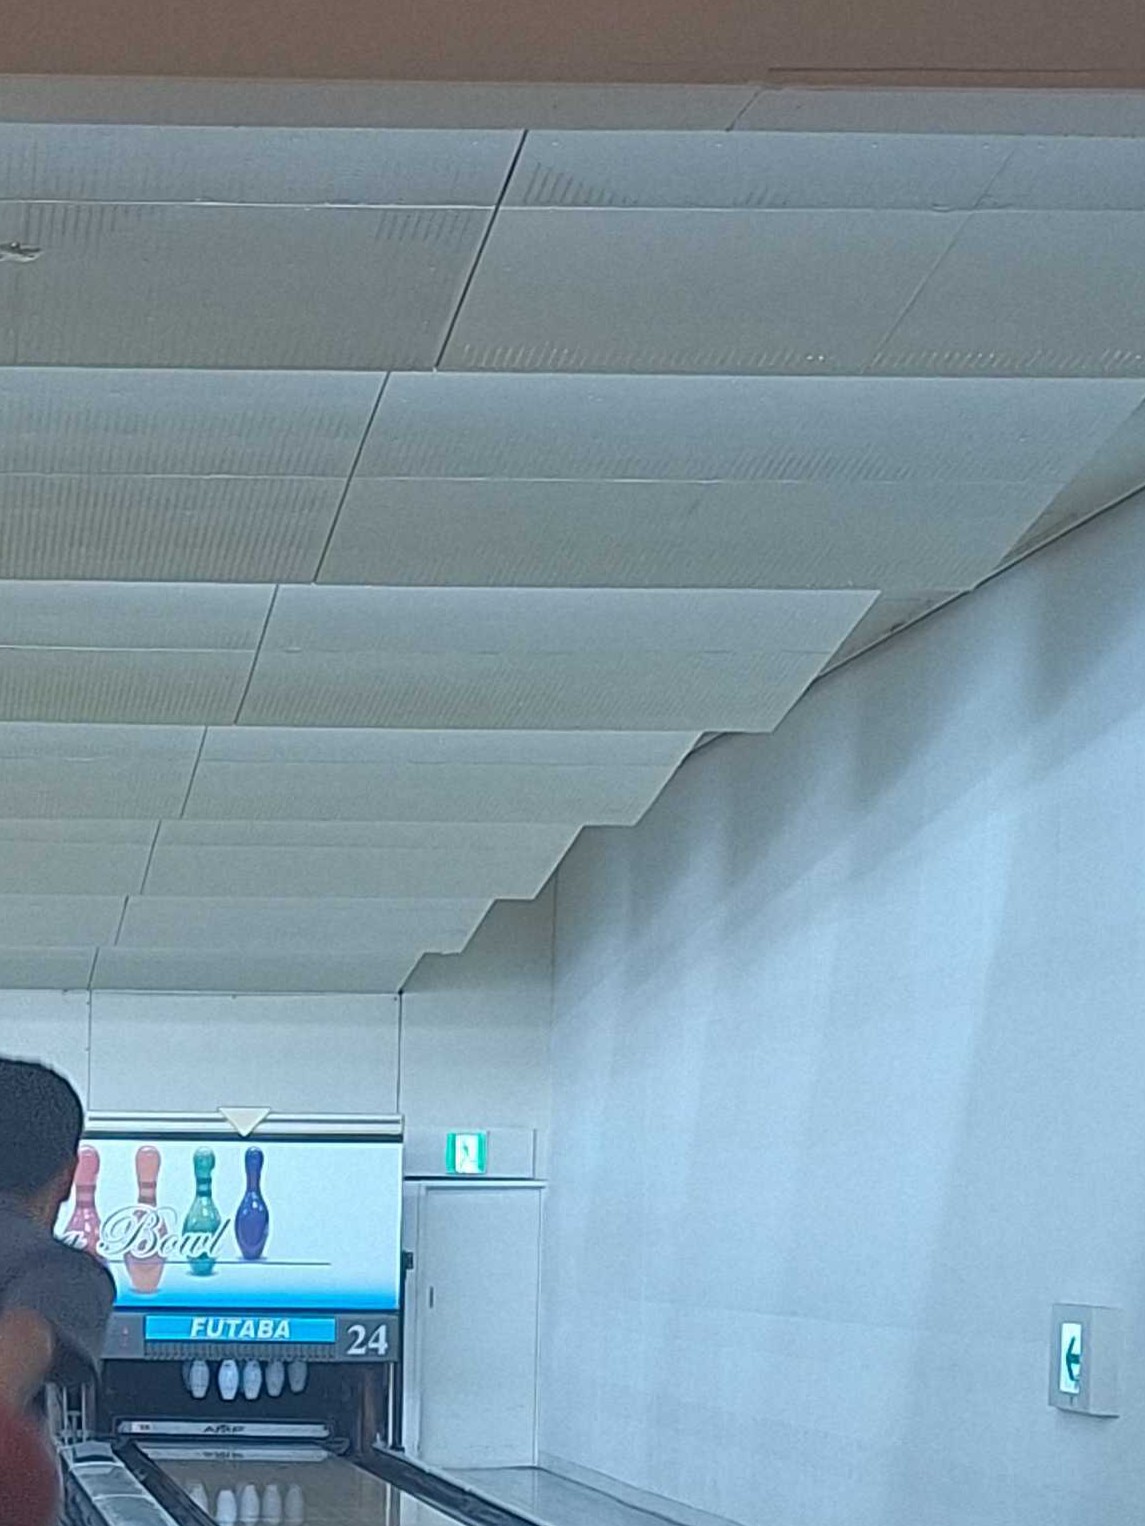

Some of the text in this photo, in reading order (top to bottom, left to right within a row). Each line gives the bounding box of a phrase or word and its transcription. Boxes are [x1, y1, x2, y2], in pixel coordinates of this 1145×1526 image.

[98, 1204, 231, 1257] Bowl
[190, 1316, 291, 1339] FUTABA
[346, 1324, 389, 1356] 24
